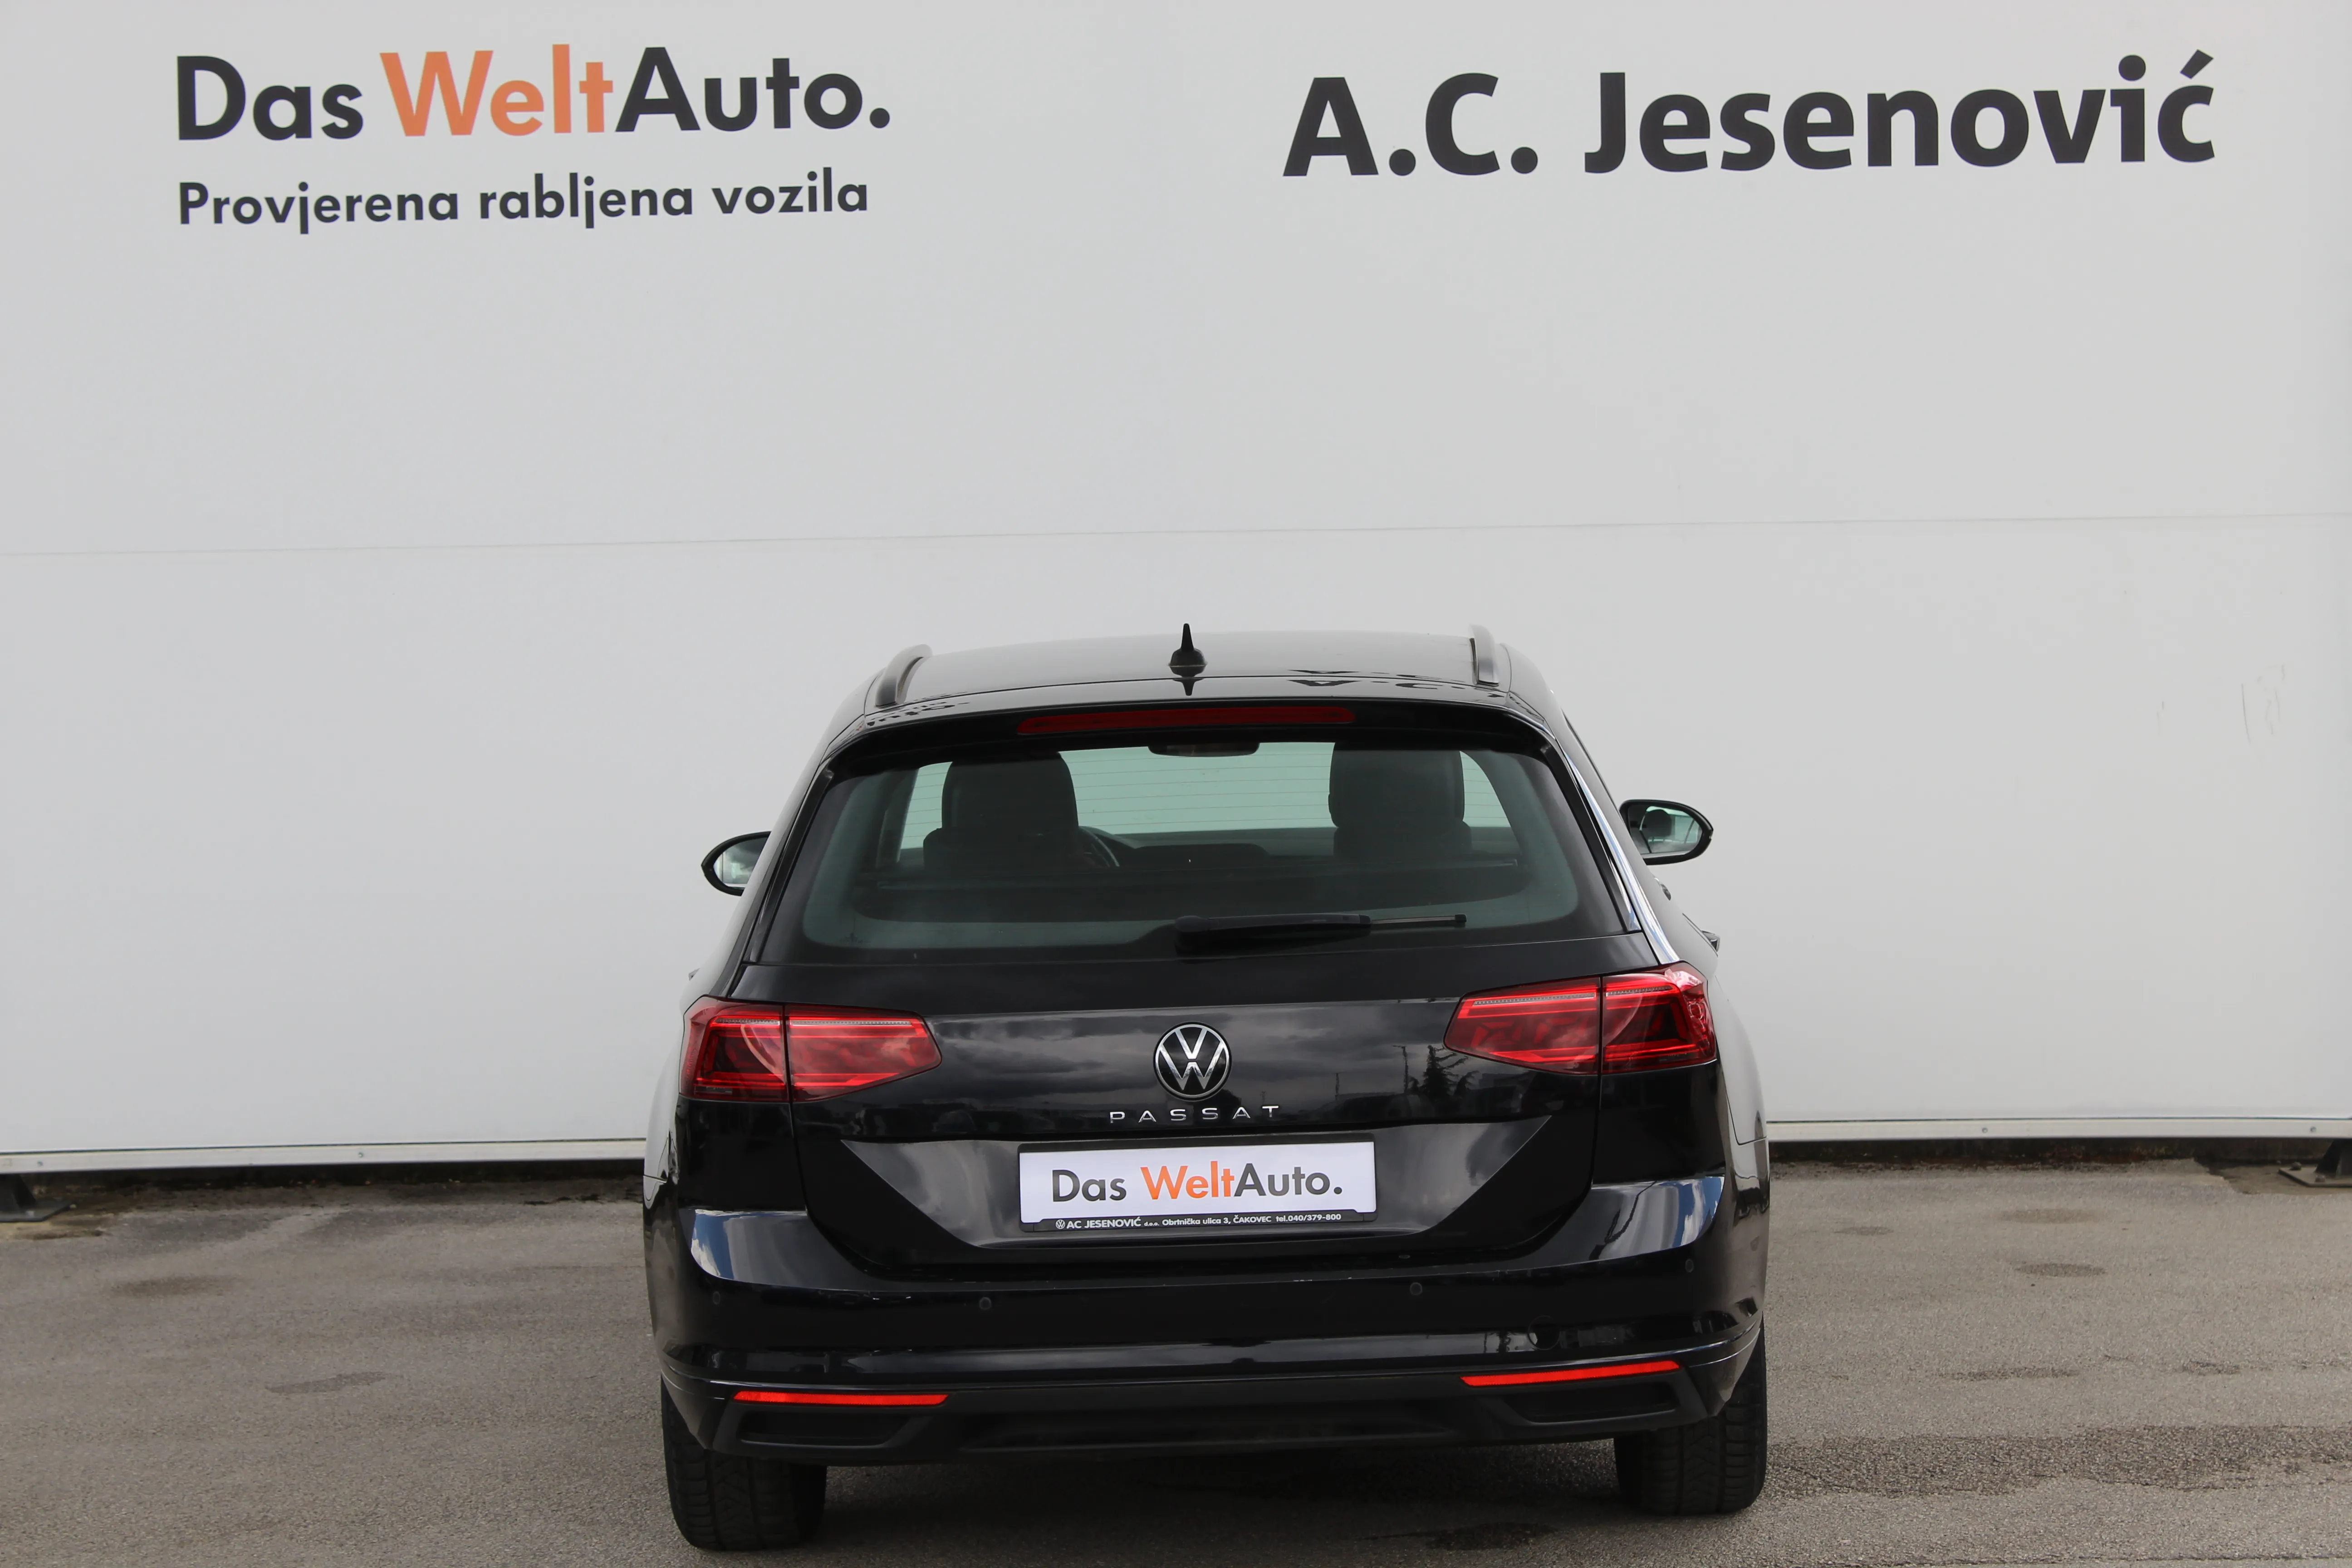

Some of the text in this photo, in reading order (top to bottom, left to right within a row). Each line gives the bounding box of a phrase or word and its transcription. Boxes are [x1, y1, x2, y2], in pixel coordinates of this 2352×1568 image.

[176, 44, 890, 141] Das WeltAuto.
[1283, 49, 2215, 177] A.C. Jesenović
[179, 166, 867, 235] Provjerena rabljena vozila
[1109, 1105, 1279, 1123] PASSAT
[1052, 1161, 1343, 1202] Das WeltAuto.
[1066, 1220, 1082, 1229] AC
[1084, 1216, 1142, 1229] JESENOVIĆ
[1162, 1218, 1200, 1226] Obrtnička
[1233, 1215, 1272, 1224] ČAKOVEC
[1275, 1214, 1342, 1222] tel.040/379-800
